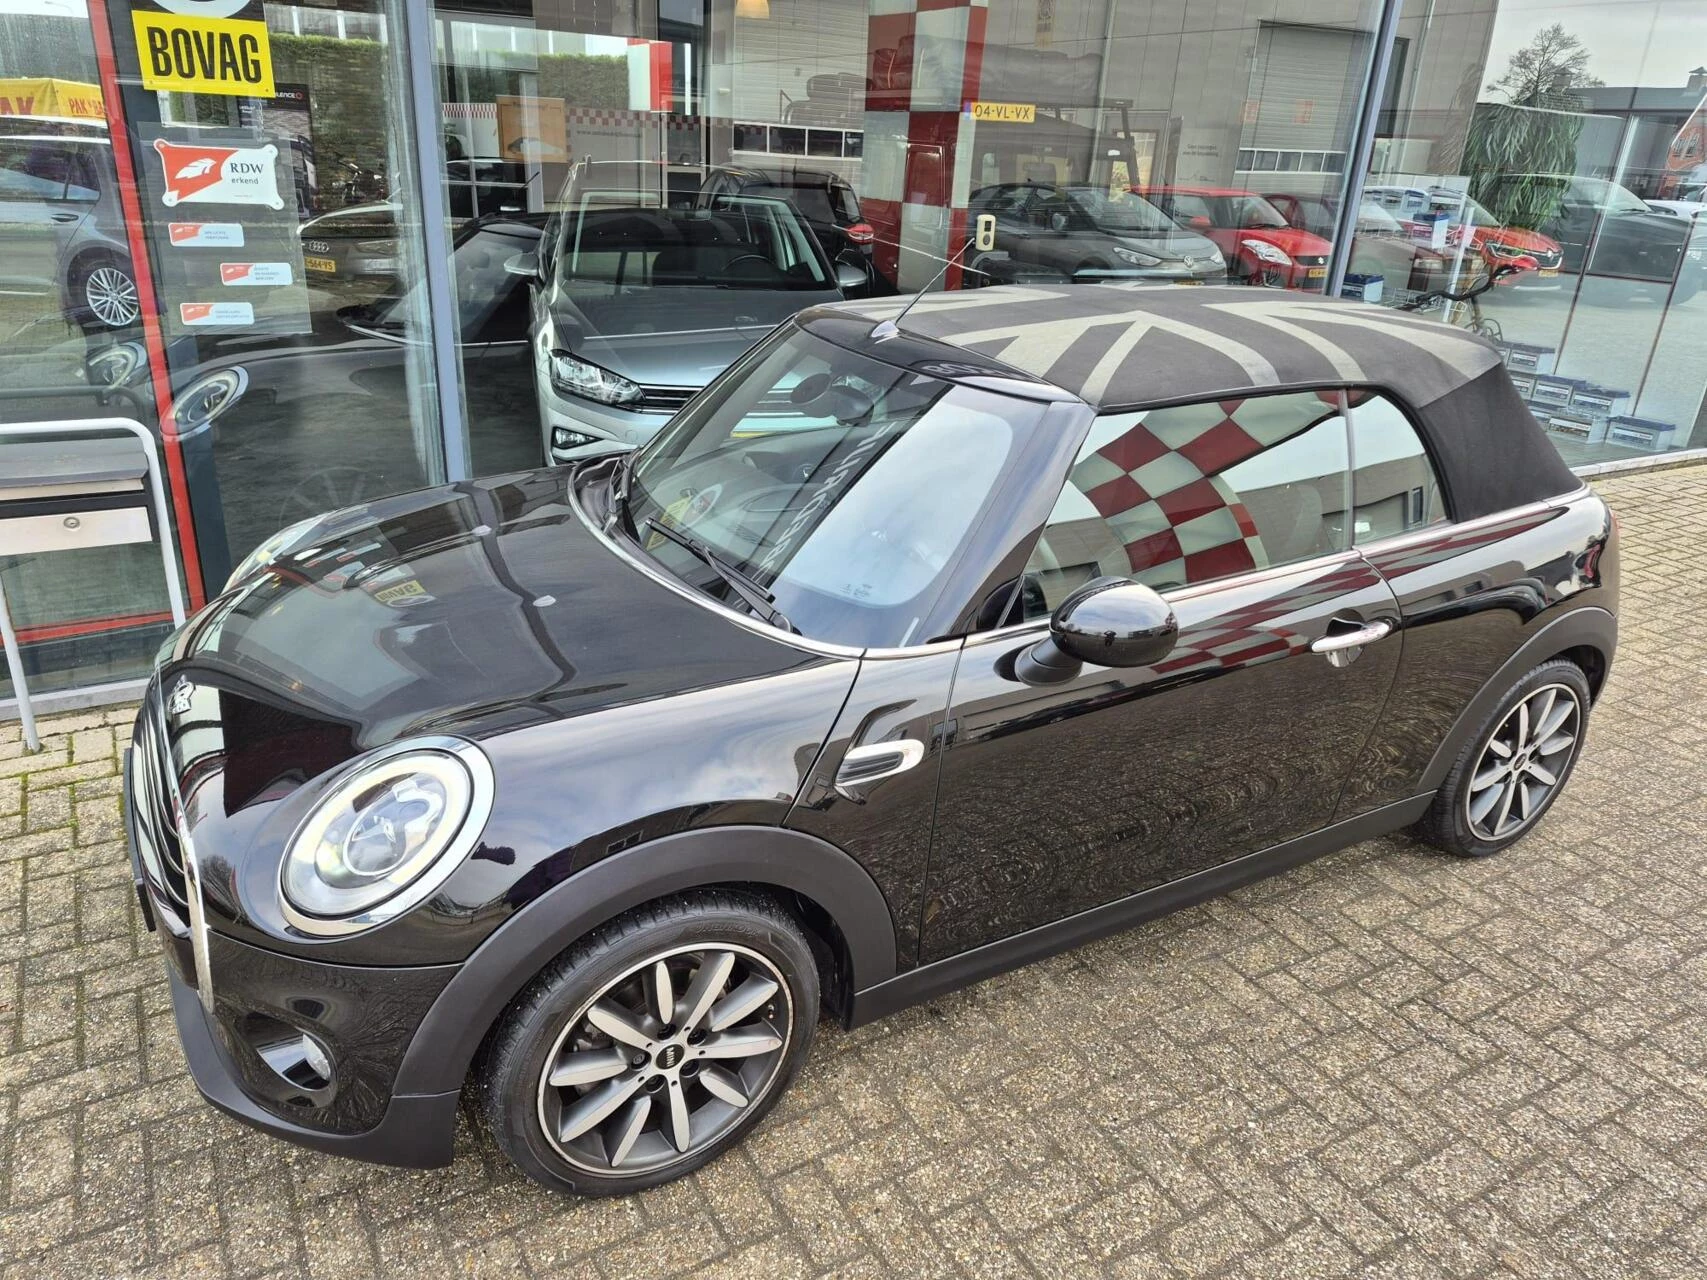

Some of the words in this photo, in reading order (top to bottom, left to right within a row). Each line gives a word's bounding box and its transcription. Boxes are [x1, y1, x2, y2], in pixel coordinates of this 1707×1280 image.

[147, 26, 262, 84] BOVAG
[975, 104, 1030, 120] 04-VL-VX
[230, 162, 264, 174] RDW
[231, 176, 259, 184] erkend
[666, 1046, 675, 1067] MINI
